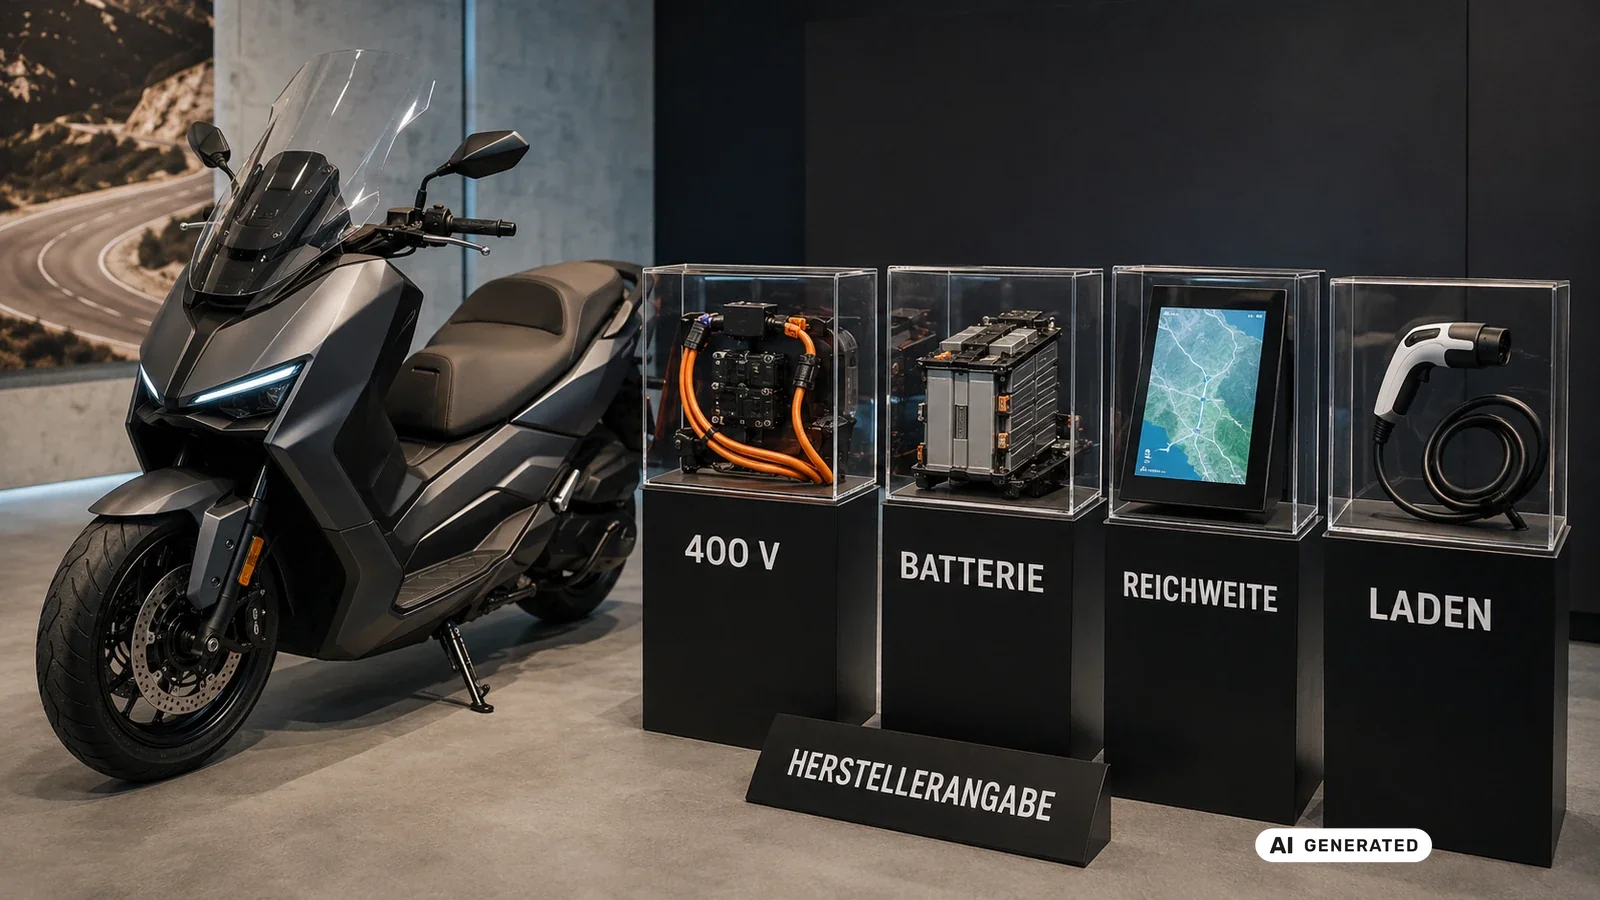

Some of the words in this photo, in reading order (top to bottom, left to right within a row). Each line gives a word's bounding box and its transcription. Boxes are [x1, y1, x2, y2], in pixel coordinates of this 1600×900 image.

[684, 534, 749, 568] 400
[758, 540, 781, 571] V
[900, 550, 1045, 594] BATTERIE
[1122, 570, 1278, 613] REICHWEITE
[1369, 586, 1493, 632] LADEN
[787, 748, 1057, 822] HERSTELLERANGABE
